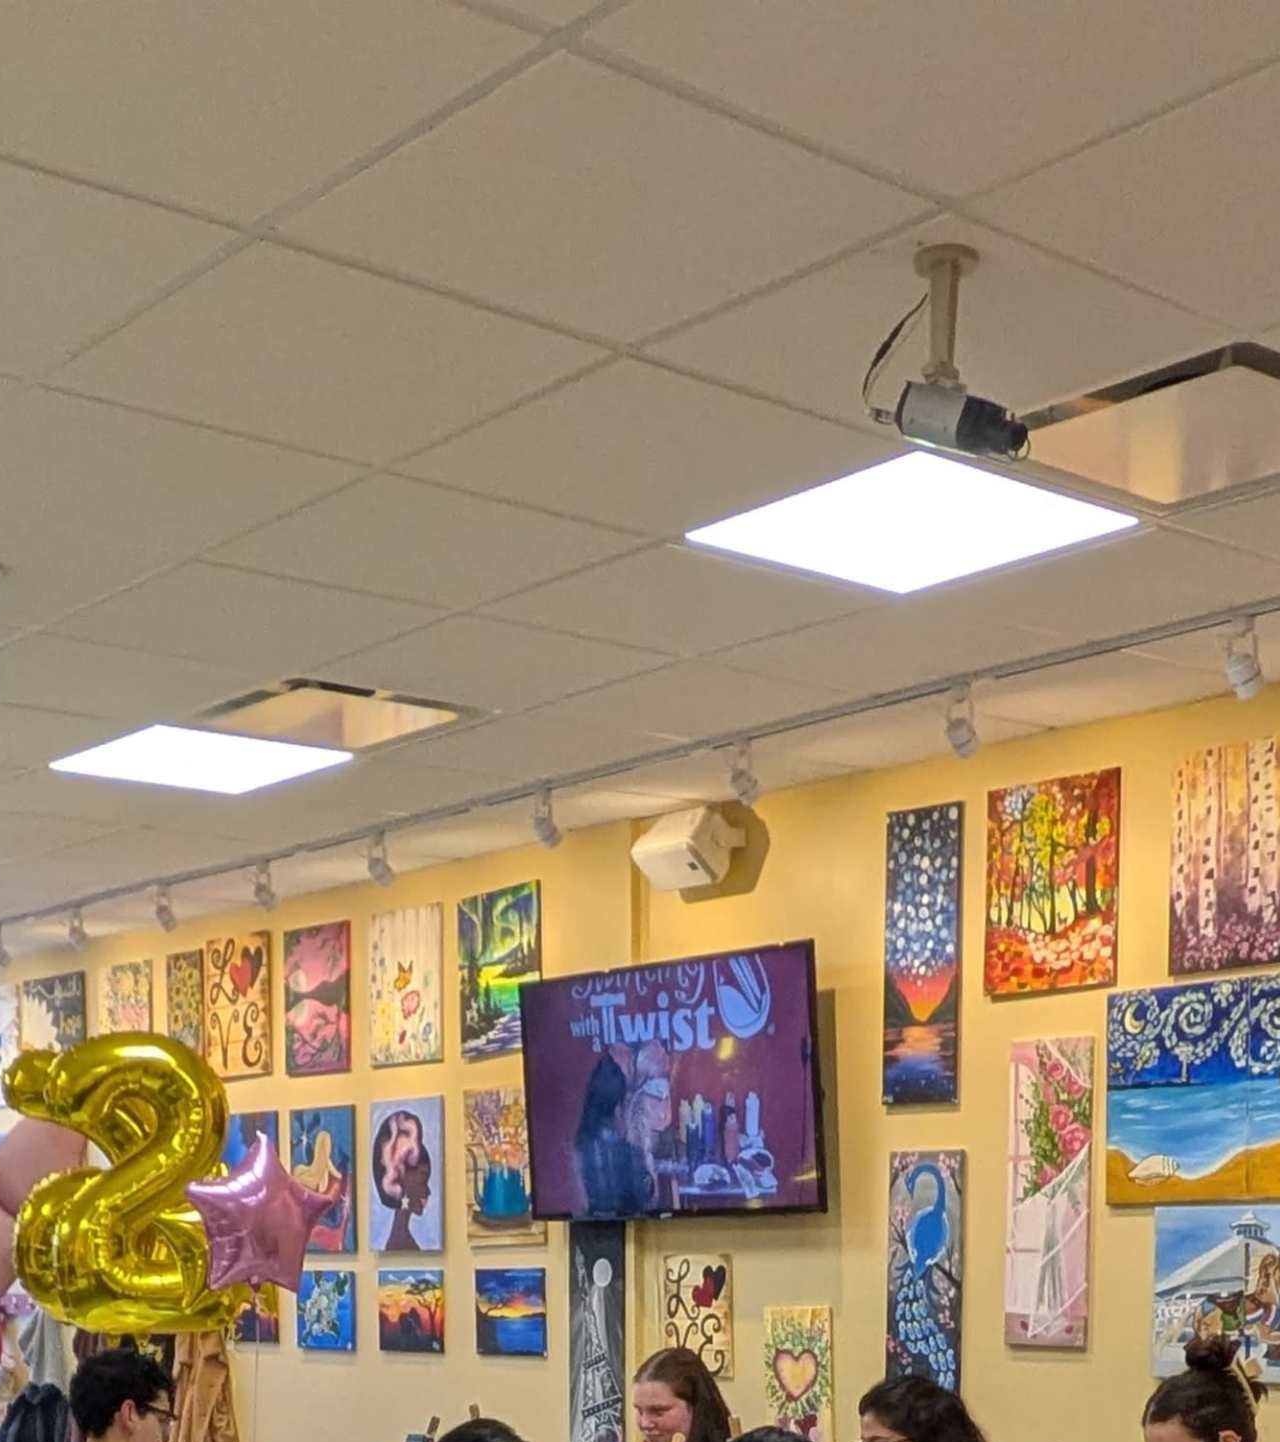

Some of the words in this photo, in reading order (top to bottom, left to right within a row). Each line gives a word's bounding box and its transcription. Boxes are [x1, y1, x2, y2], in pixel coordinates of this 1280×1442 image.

[569, 1012, 600, 1038] with
[589, 990, 716, 1052] Twist
[591, 1037, 602, 1053] a
